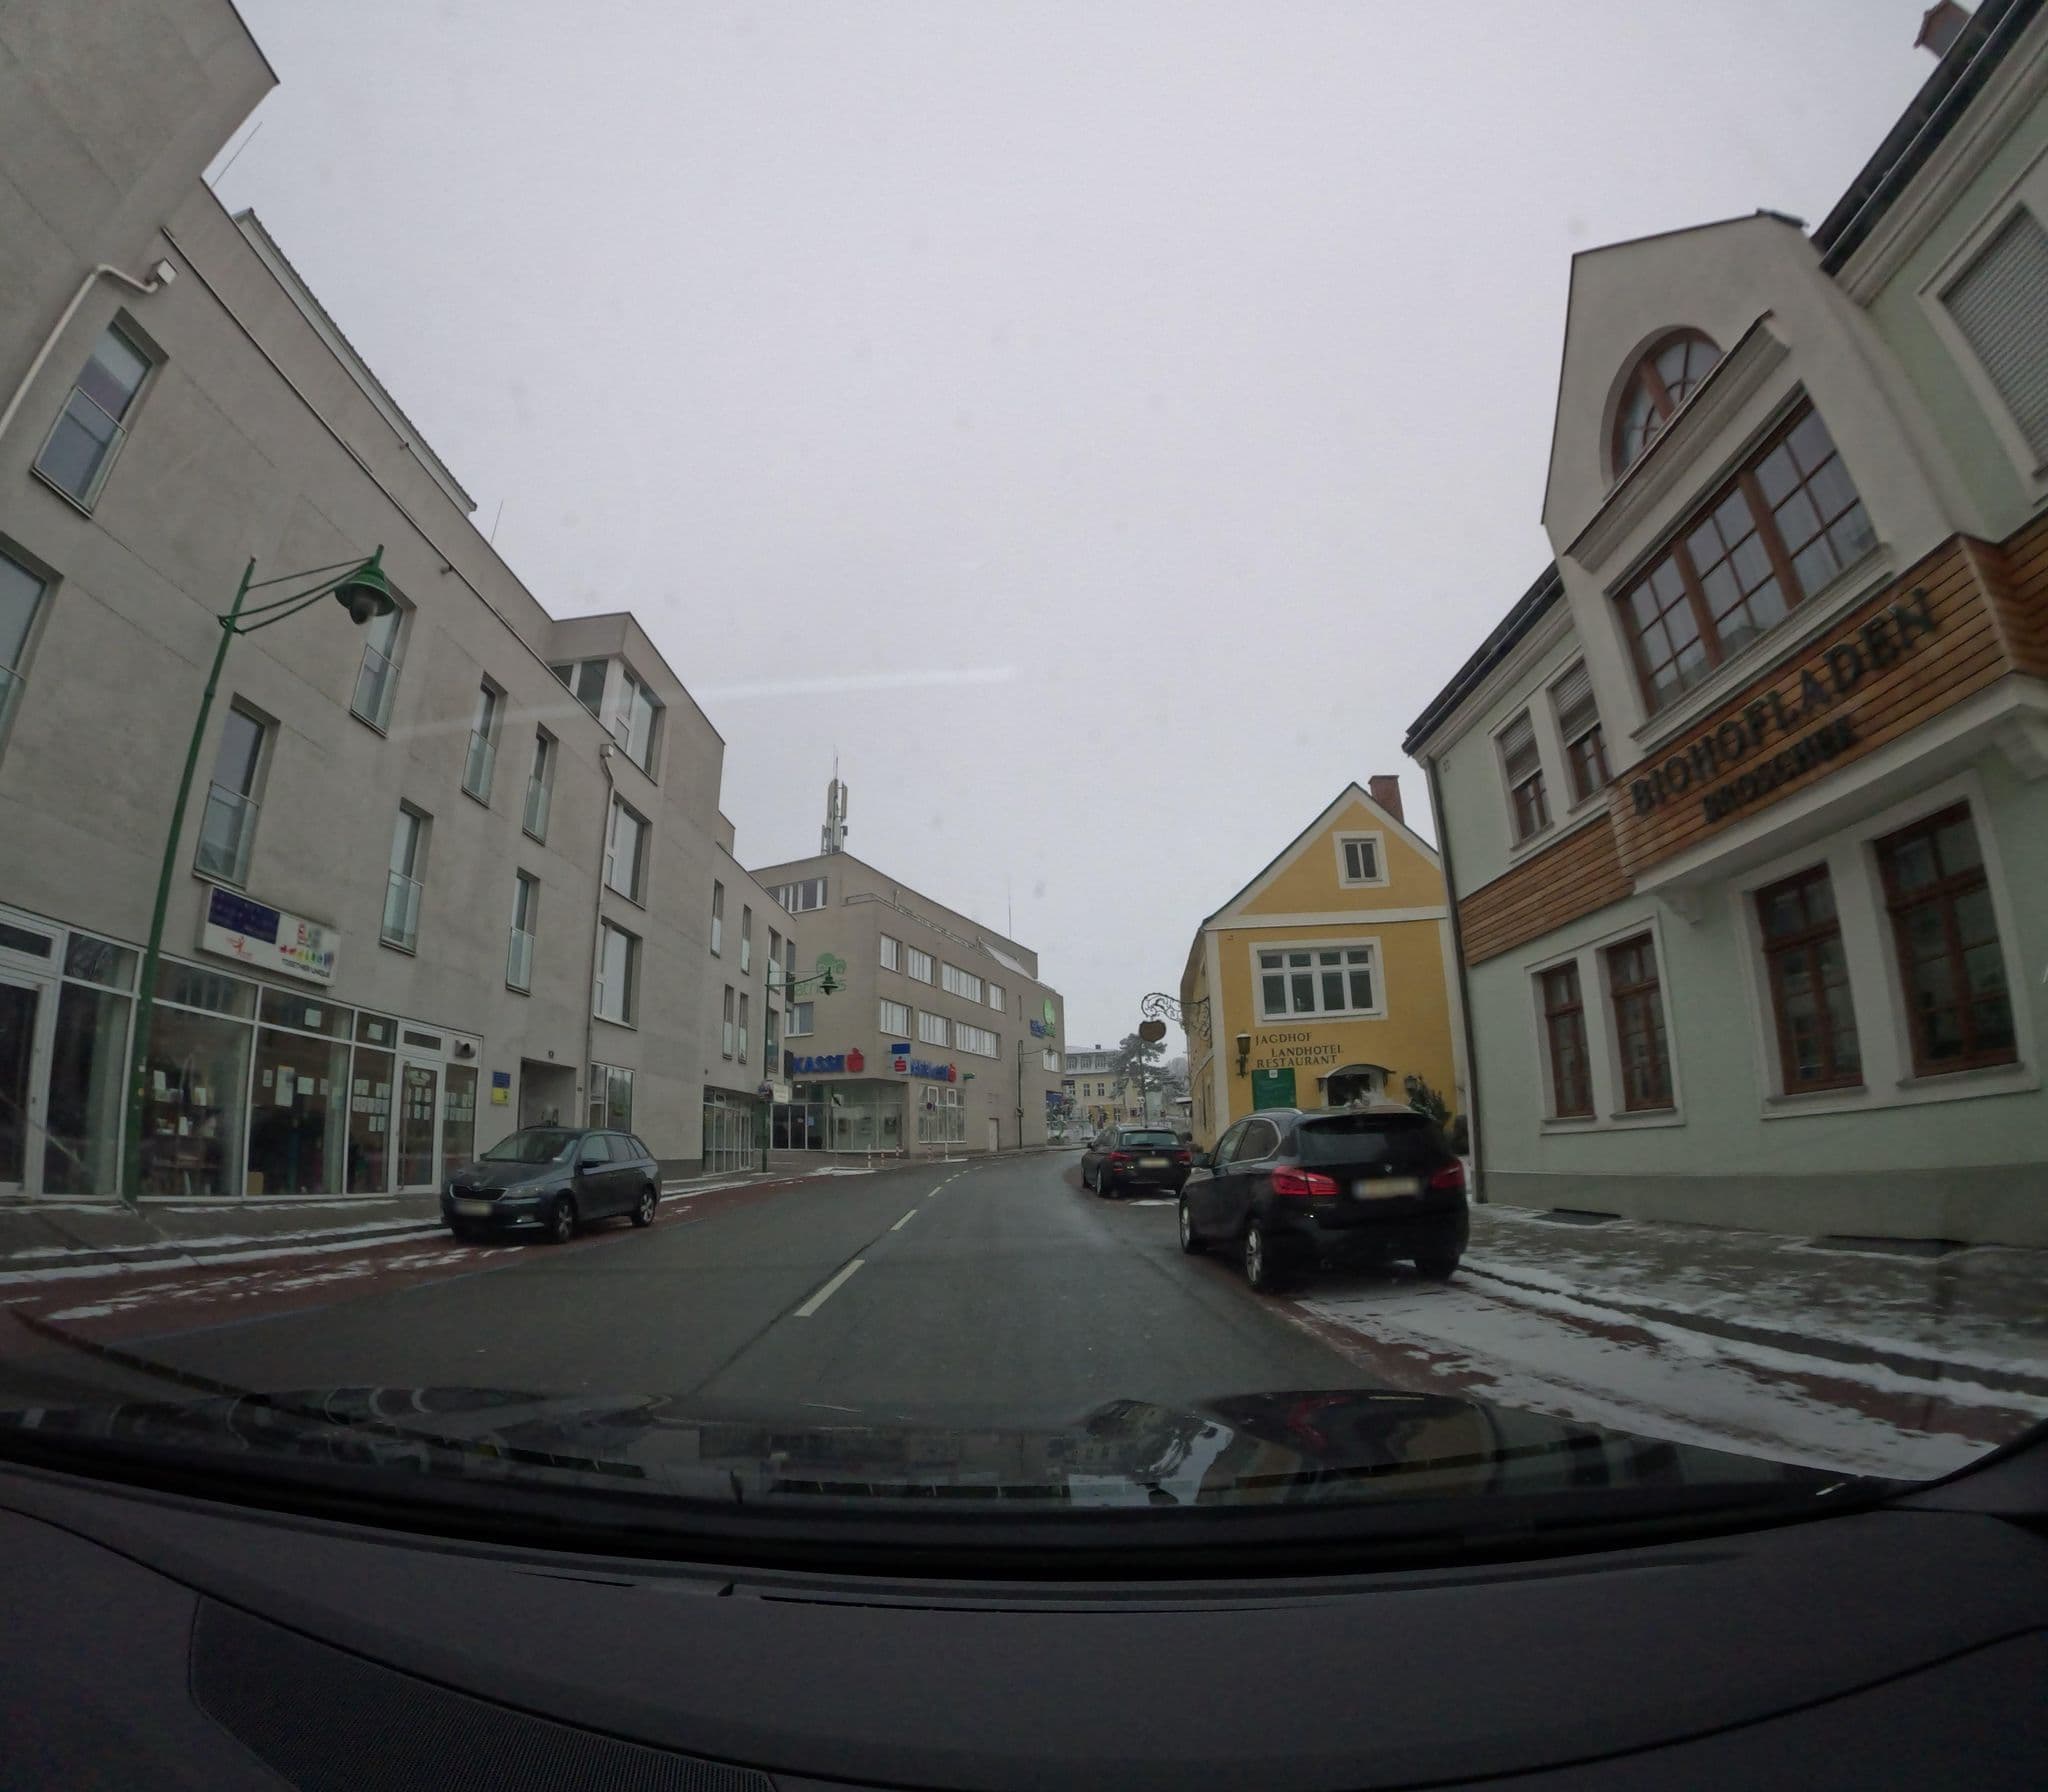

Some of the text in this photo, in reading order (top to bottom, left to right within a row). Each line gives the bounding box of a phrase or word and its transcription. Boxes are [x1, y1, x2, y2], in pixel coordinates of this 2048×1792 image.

[1631, 587, 1937, 815] BIOHOFLADEN
[1256, 1032, 1312, 1046] JAGDHOF
[1271, 1044, 1344, 1057] LANDHOTEL
[1257, 1055, 1337, 1068] RESTAURANT
